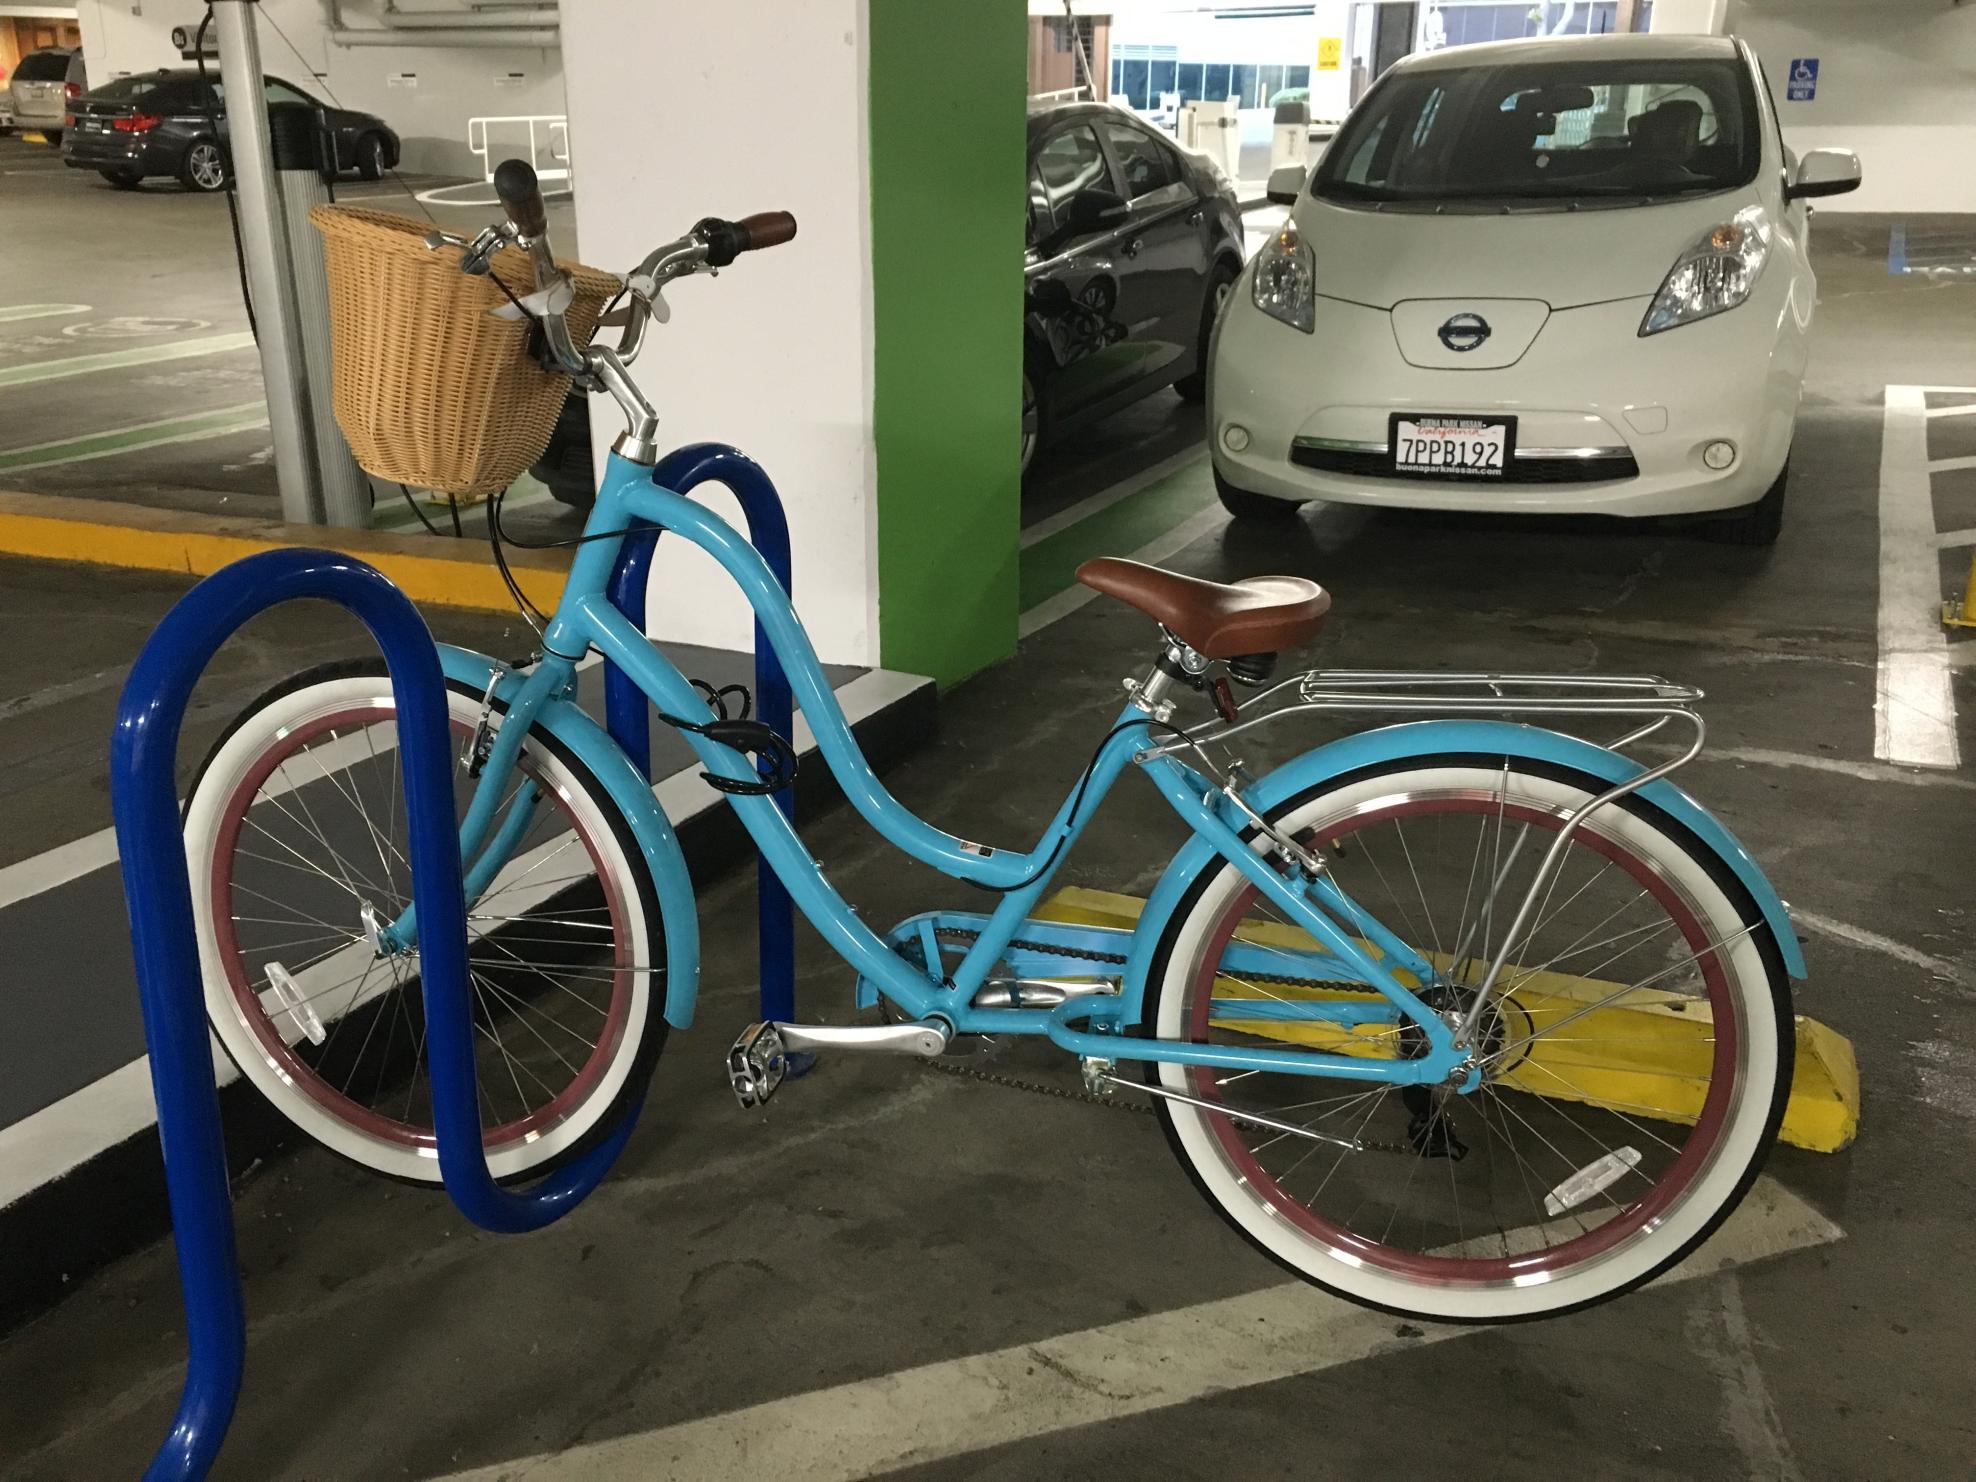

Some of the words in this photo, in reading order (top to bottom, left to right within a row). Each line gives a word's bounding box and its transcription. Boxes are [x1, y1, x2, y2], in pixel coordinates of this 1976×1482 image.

[1441, 419, 1459, 428] PARK
[1460, 420, 1483, 429] NISSAN
[1417, 427, 1480, 439] California
[1402, 439, 1499, 467] 7PPB192
